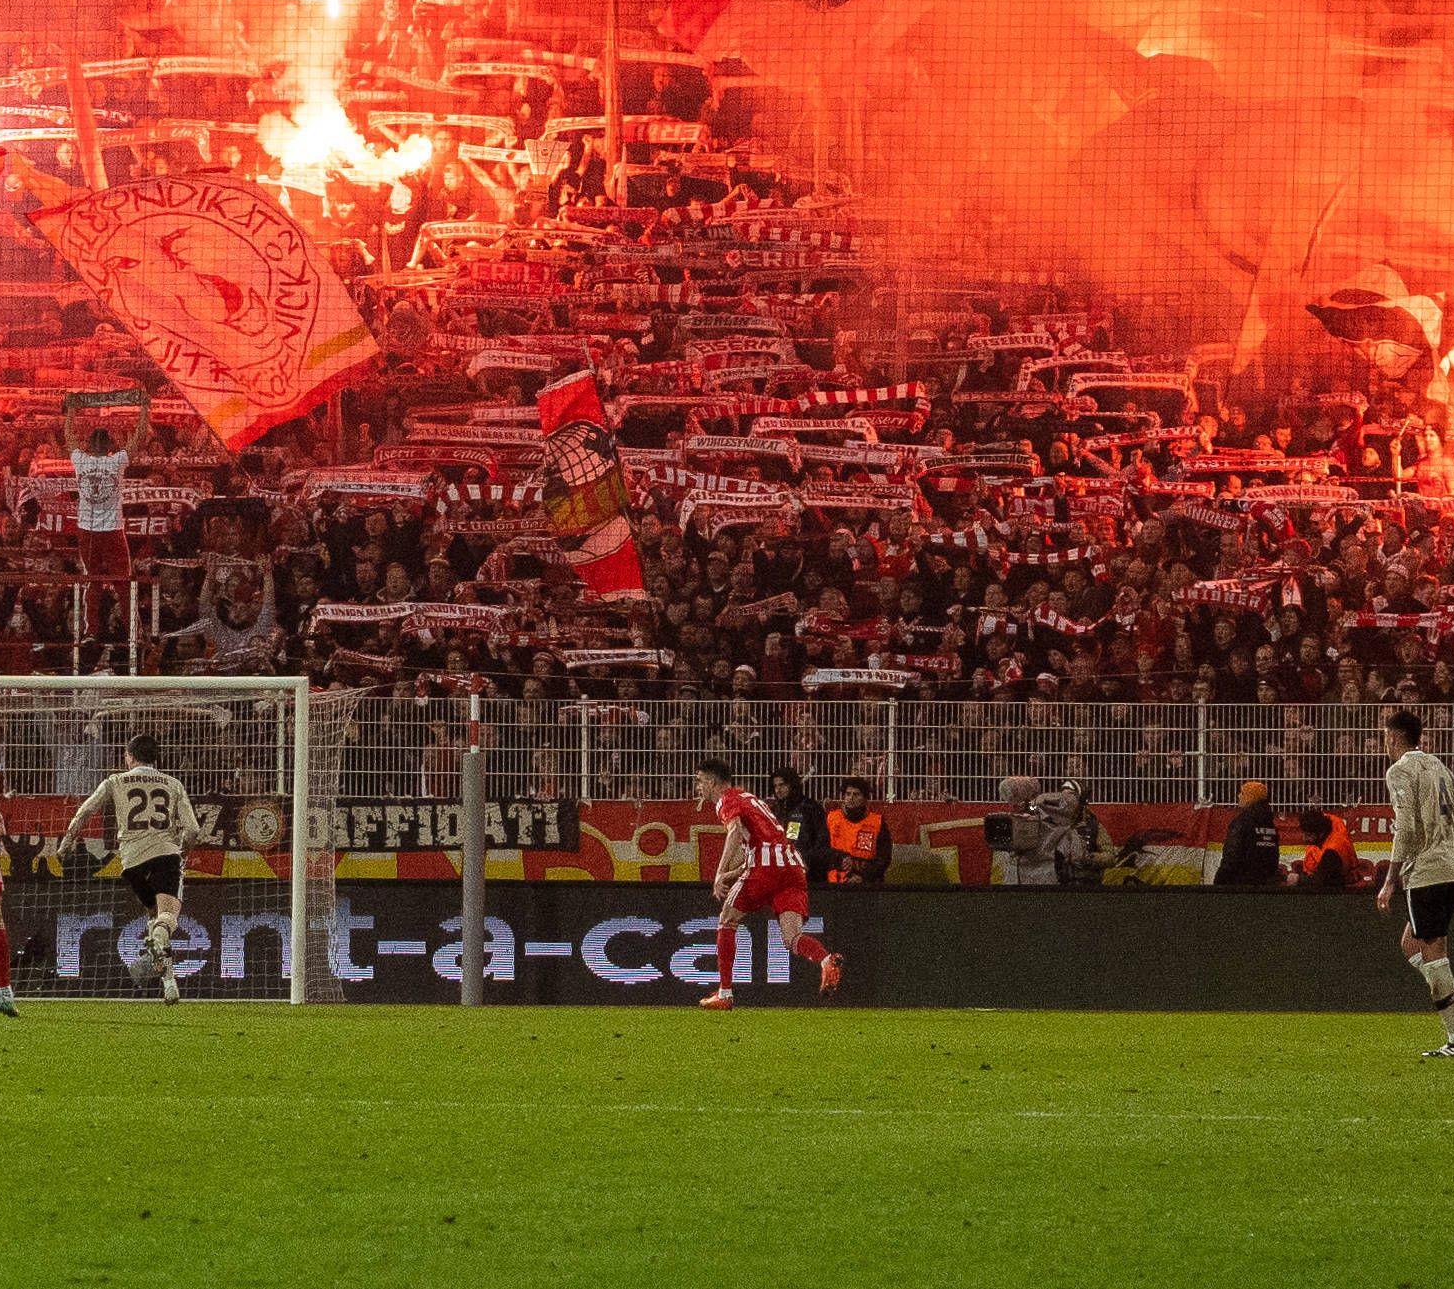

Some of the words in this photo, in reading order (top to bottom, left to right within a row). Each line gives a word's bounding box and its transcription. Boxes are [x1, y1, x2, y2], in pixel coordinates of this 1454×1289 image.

[693, 341, 775, 355] EISERN
[471, 519, 511, 531] Union
[1184, 506, 1240, 530] UNIONER
[126, 787, 170, 831] 23
